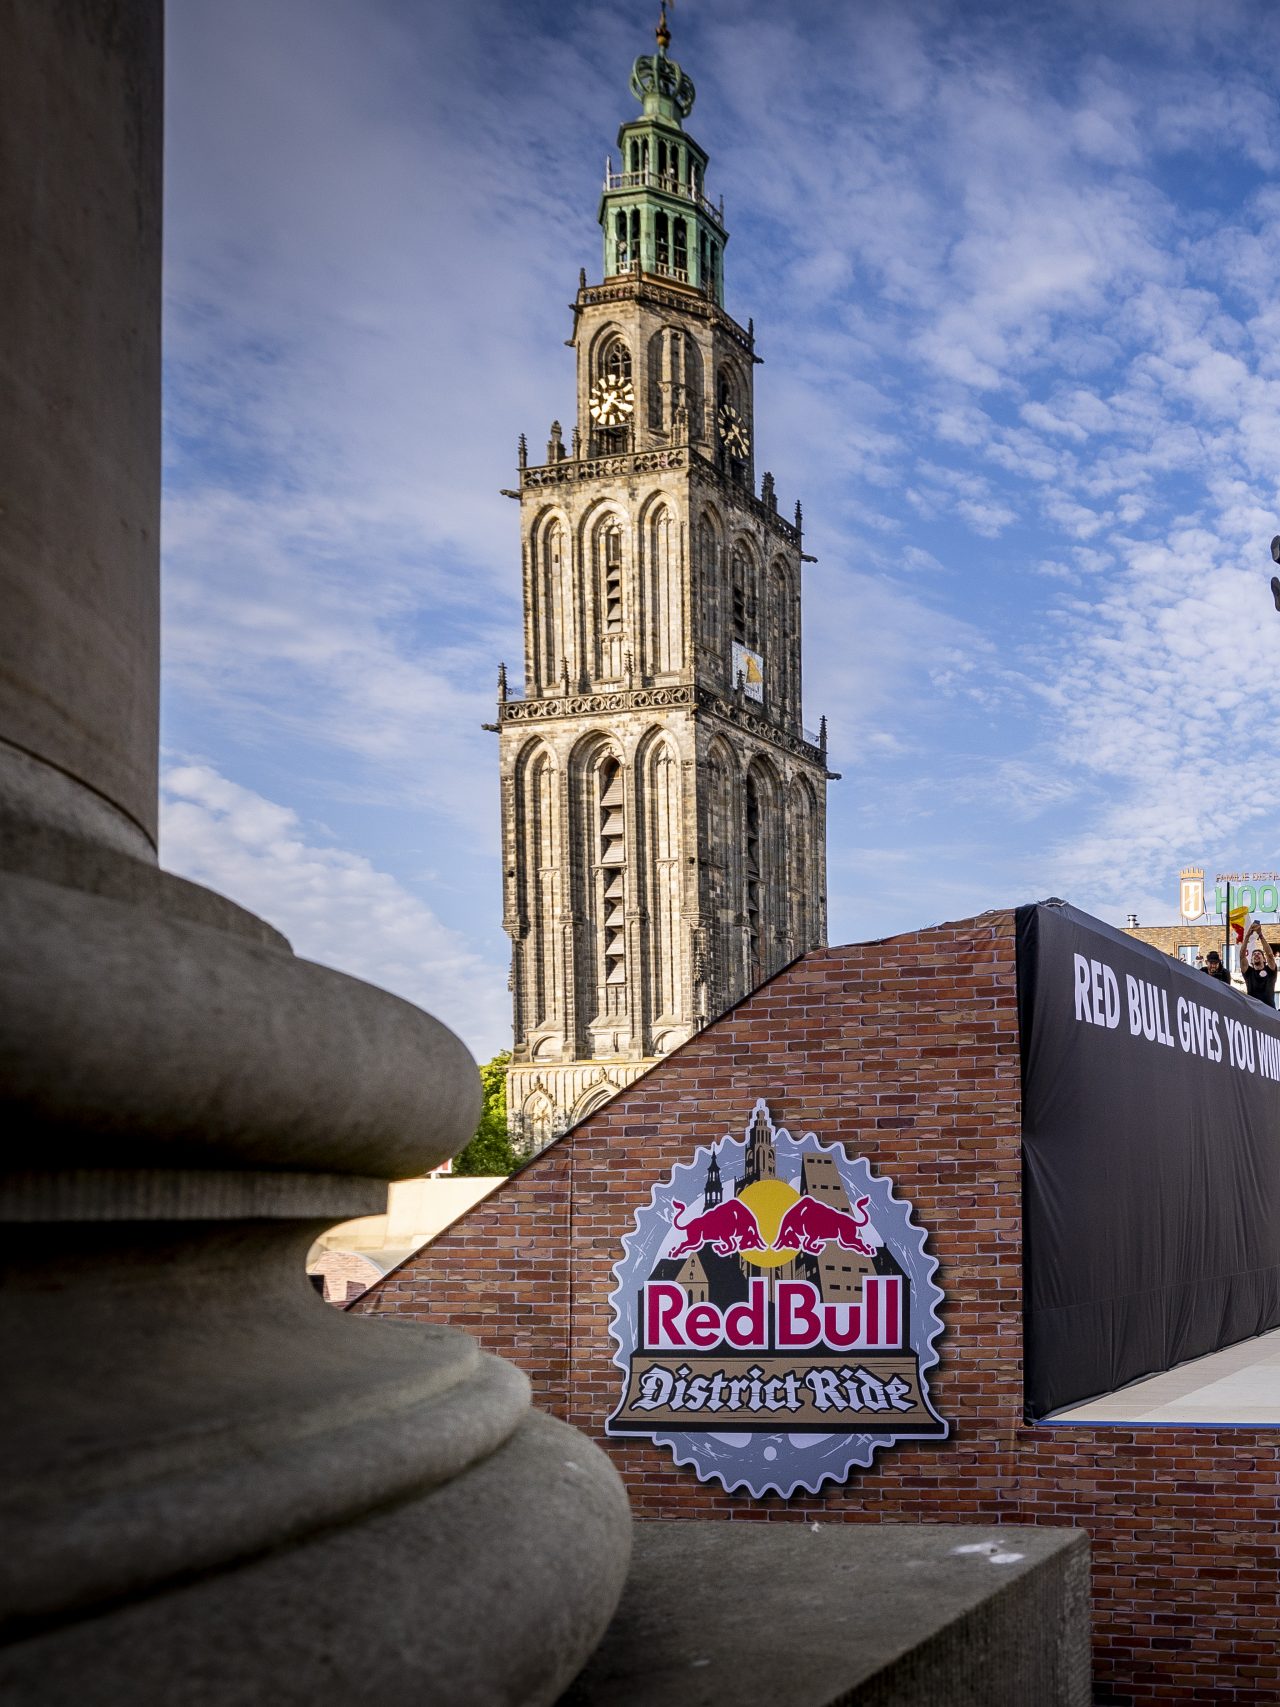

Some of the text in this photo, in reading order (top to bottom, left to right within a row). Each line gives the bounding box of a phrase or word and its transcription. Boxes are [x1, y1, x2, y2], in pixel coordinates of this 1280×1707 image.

[1074, 952, 1121, 1029] RED
[1126, 973, 1175, 1048] BULL
[1177, 996, 1222, 1063] GIVES
[1223, 1015, 1255, 1074] YOU
[645, 1279, 900, 1347] Red Bull
[632, 1364, 918, 1415] District Ride
